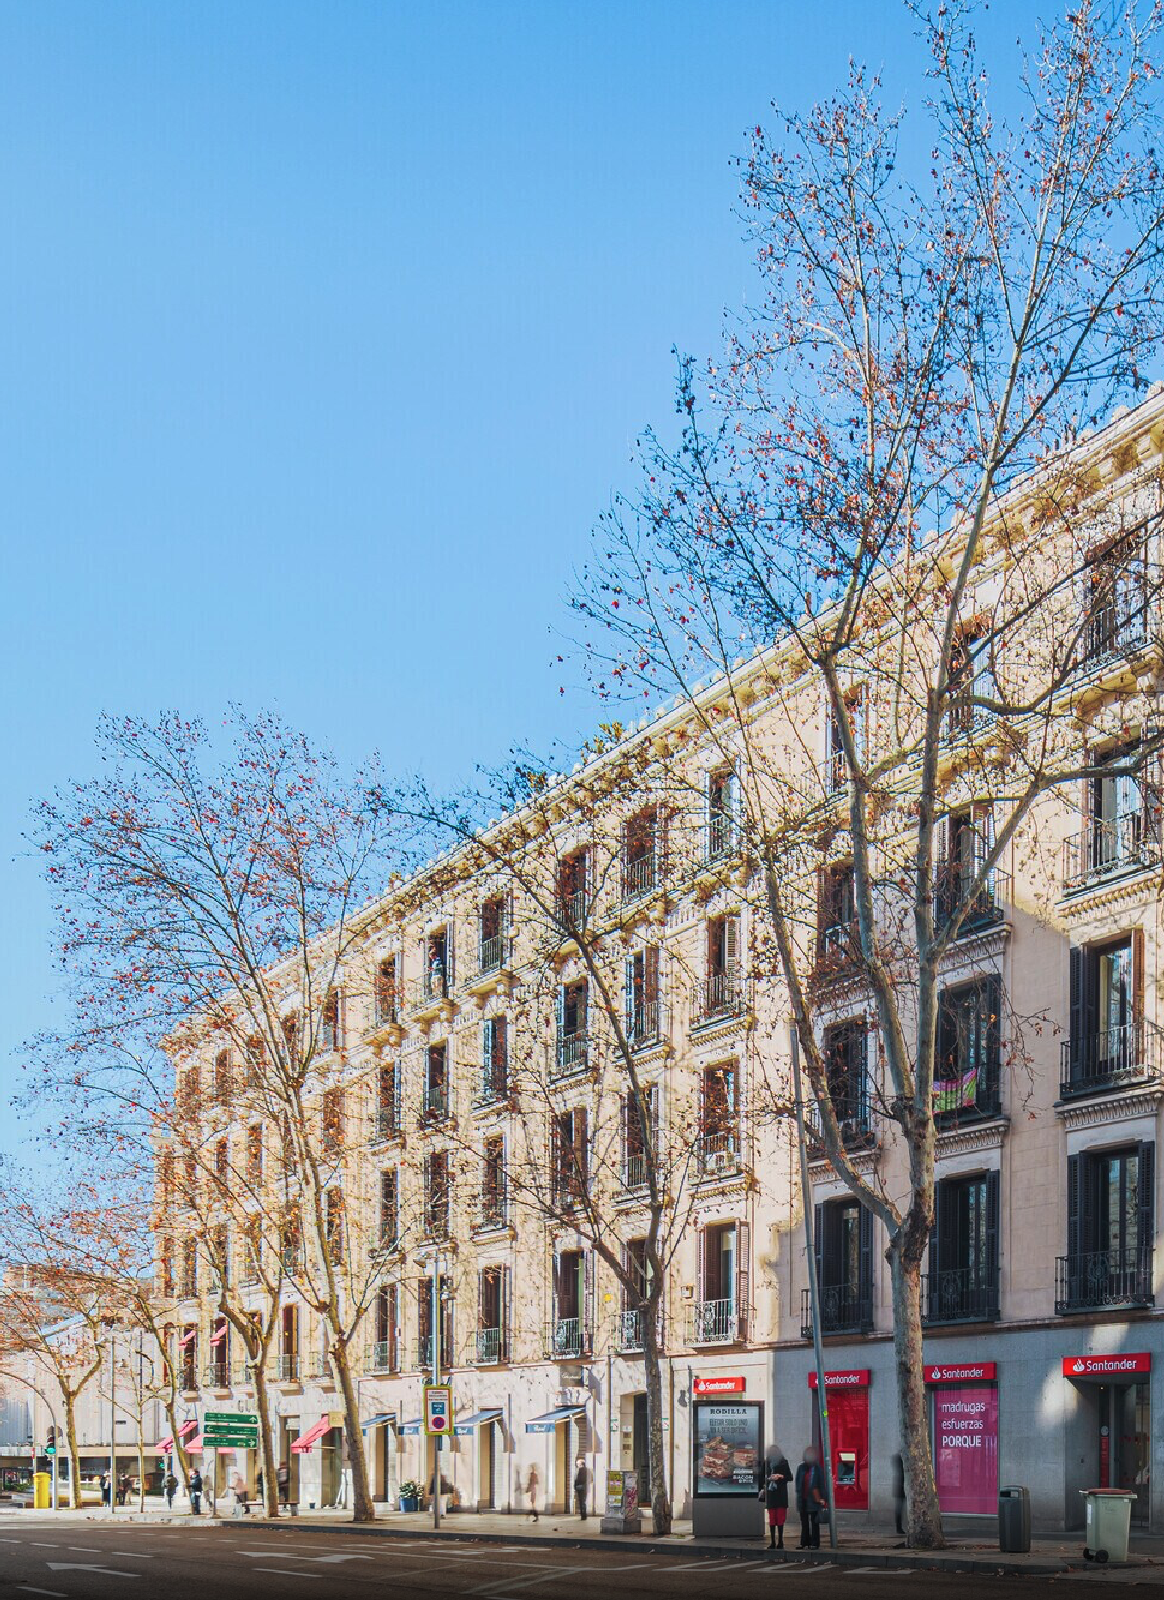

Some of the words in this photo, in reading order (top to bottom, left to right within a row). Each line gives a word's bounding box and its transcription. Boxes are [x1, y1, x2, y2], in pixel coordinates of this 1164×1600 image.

[1086, 1359, 1137, 1372] Santander
[942, 1366, 983, 1379] Santander
[705, 1381, 736, 1391] Santander
[824, 1374, 861, 1385] Santander
[941, 1401, 986, 1414] madrugas
[941, 1418, 984, 1430] esfuerzas
[942, 1435, 982, 1448] PORQUE
